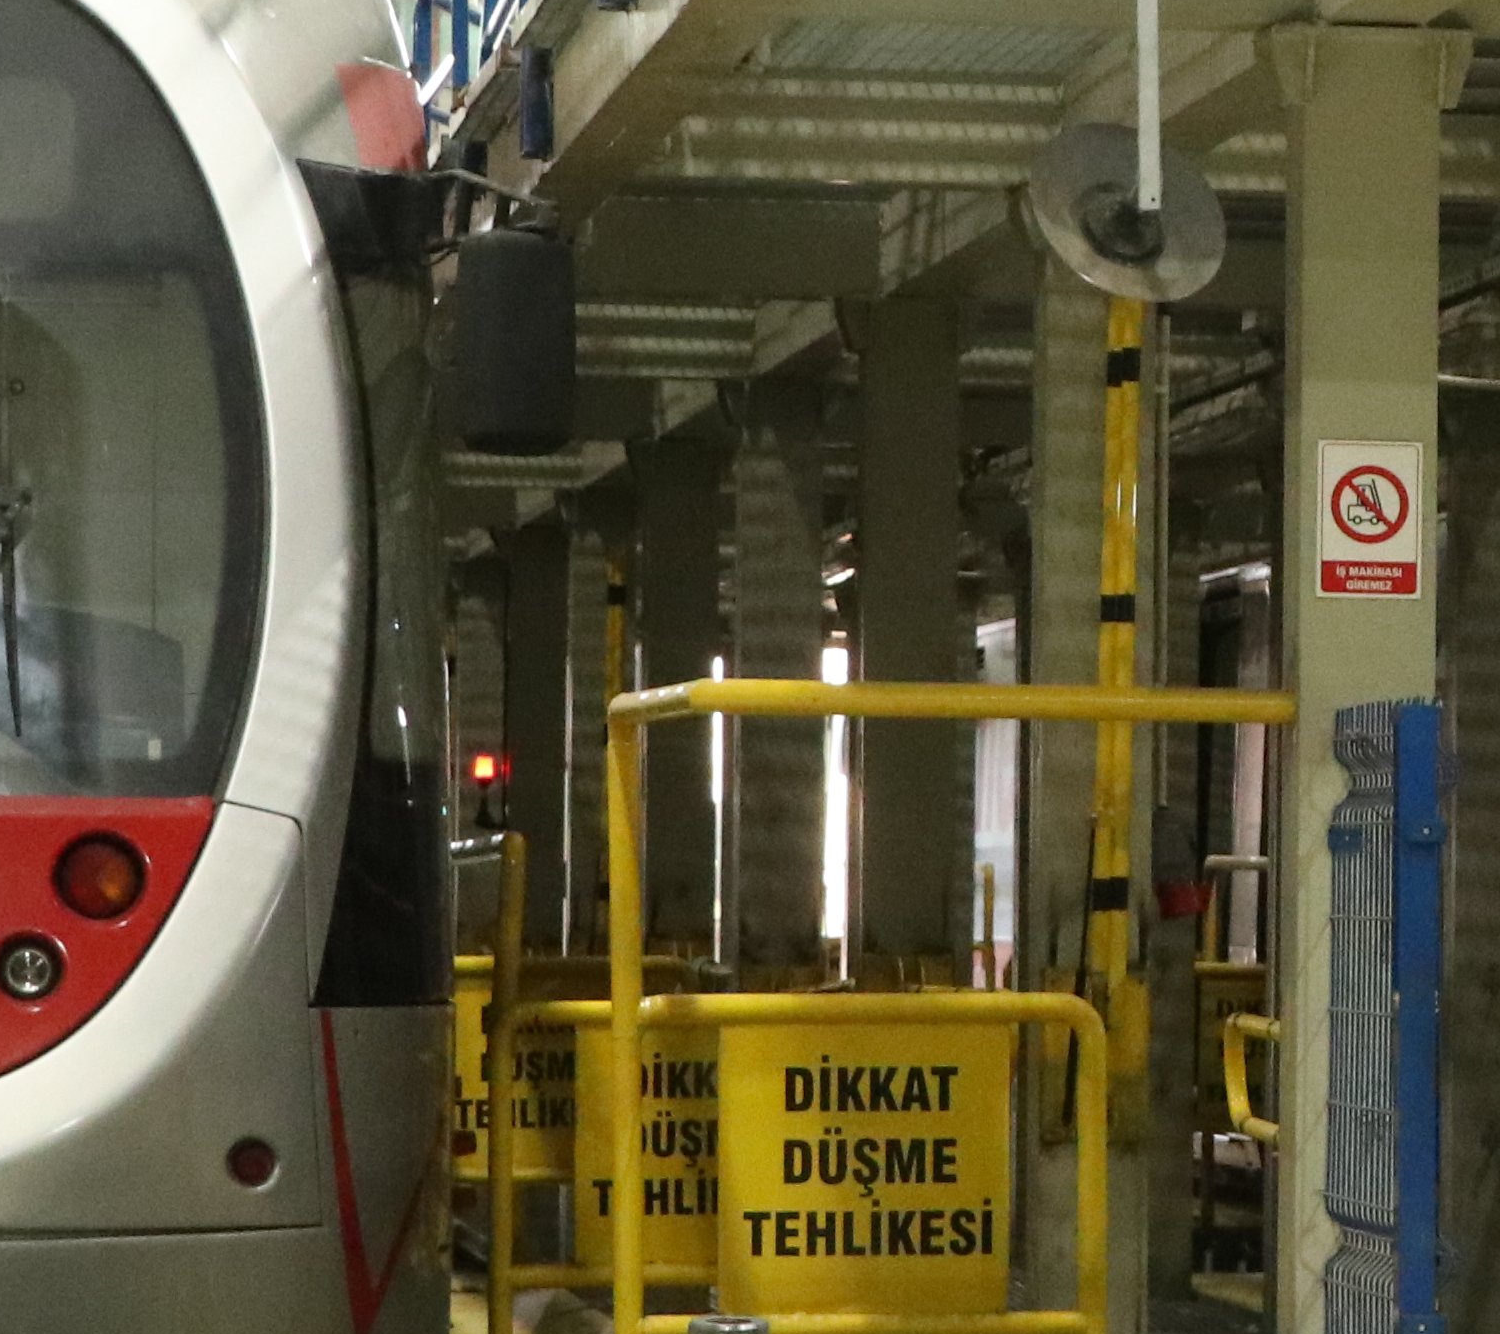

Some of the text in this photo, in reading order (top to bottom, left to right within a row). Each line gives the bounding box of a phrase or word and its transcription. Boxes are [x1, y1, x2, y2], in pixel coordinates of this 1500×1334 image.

[784, 1054, 959, 1113] DİKKAT
[783, 1126, 958, 1198] DÜŞME
[743, 1197, 993, 1257] TEHLİKESİ
